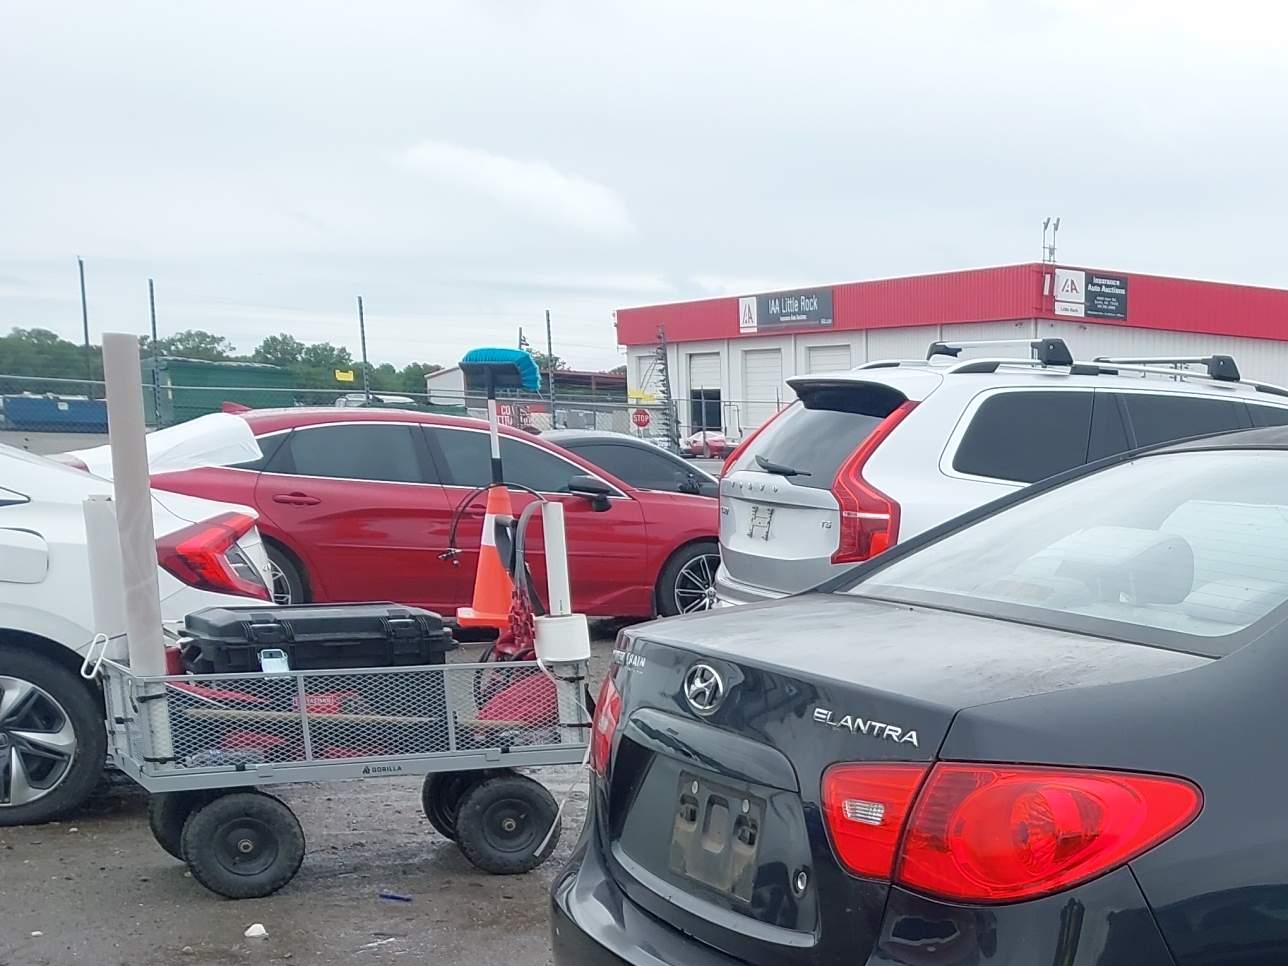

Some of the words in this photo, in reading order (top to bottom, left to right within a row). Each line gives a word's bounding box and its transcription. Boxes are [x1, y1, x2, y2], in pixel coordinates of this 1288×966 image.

[1087, 283, 1100, 292] Auto
[768, 298, 780, 315] IAA
[781, 296, 799, 313] Little
[800, 294, 818, 312] Rock
[633, 414, 649, 423] STOP
[813, 707, 919, 747] ELANTRA
